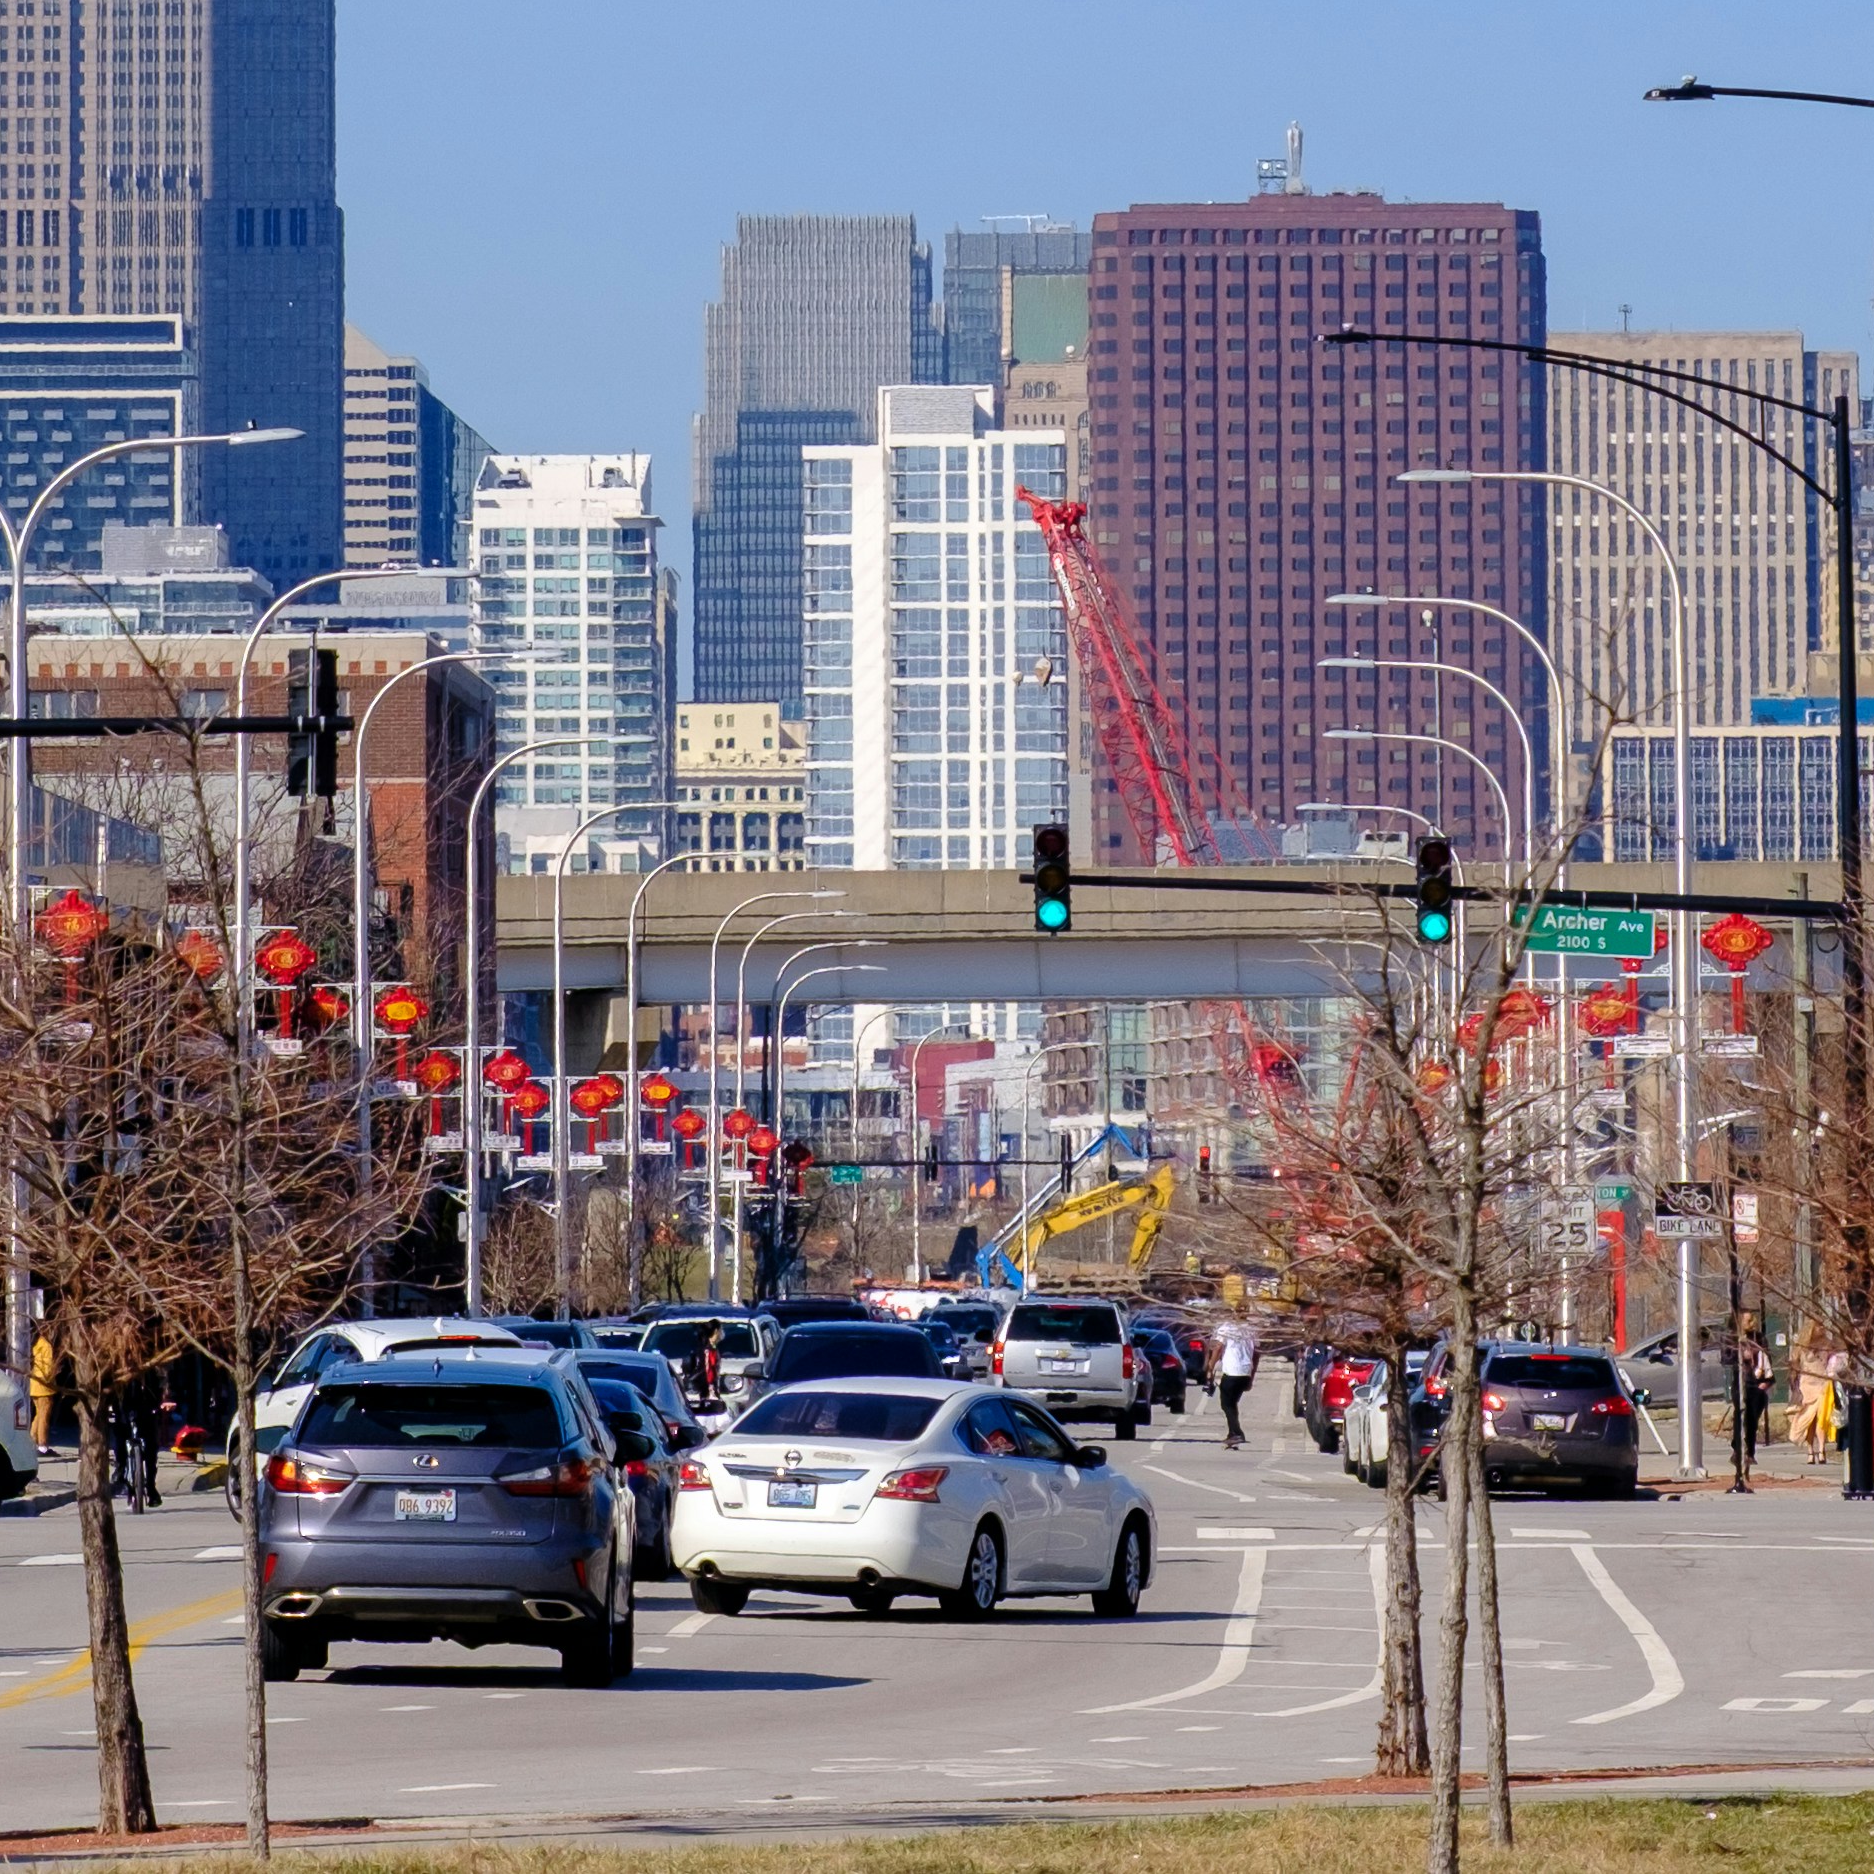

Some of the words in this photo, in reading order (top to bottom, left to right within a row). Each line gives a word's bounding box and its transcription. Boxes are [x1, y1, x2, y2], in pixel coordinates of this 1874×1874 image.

[1542, 910, 1608, 932] Archer
[1617, 920, 1645, 933] Ave
[1556, 934, 1591, 949] 2100
[1597, 936, 1606, 950] S
[1659, 1218, 1685, 1233] BIKE
[1689, 1219, 1721, 1233] LANE
[1547, 1222, 1588, 1247] 25
[425, 1498, 453, 1514] 9392
